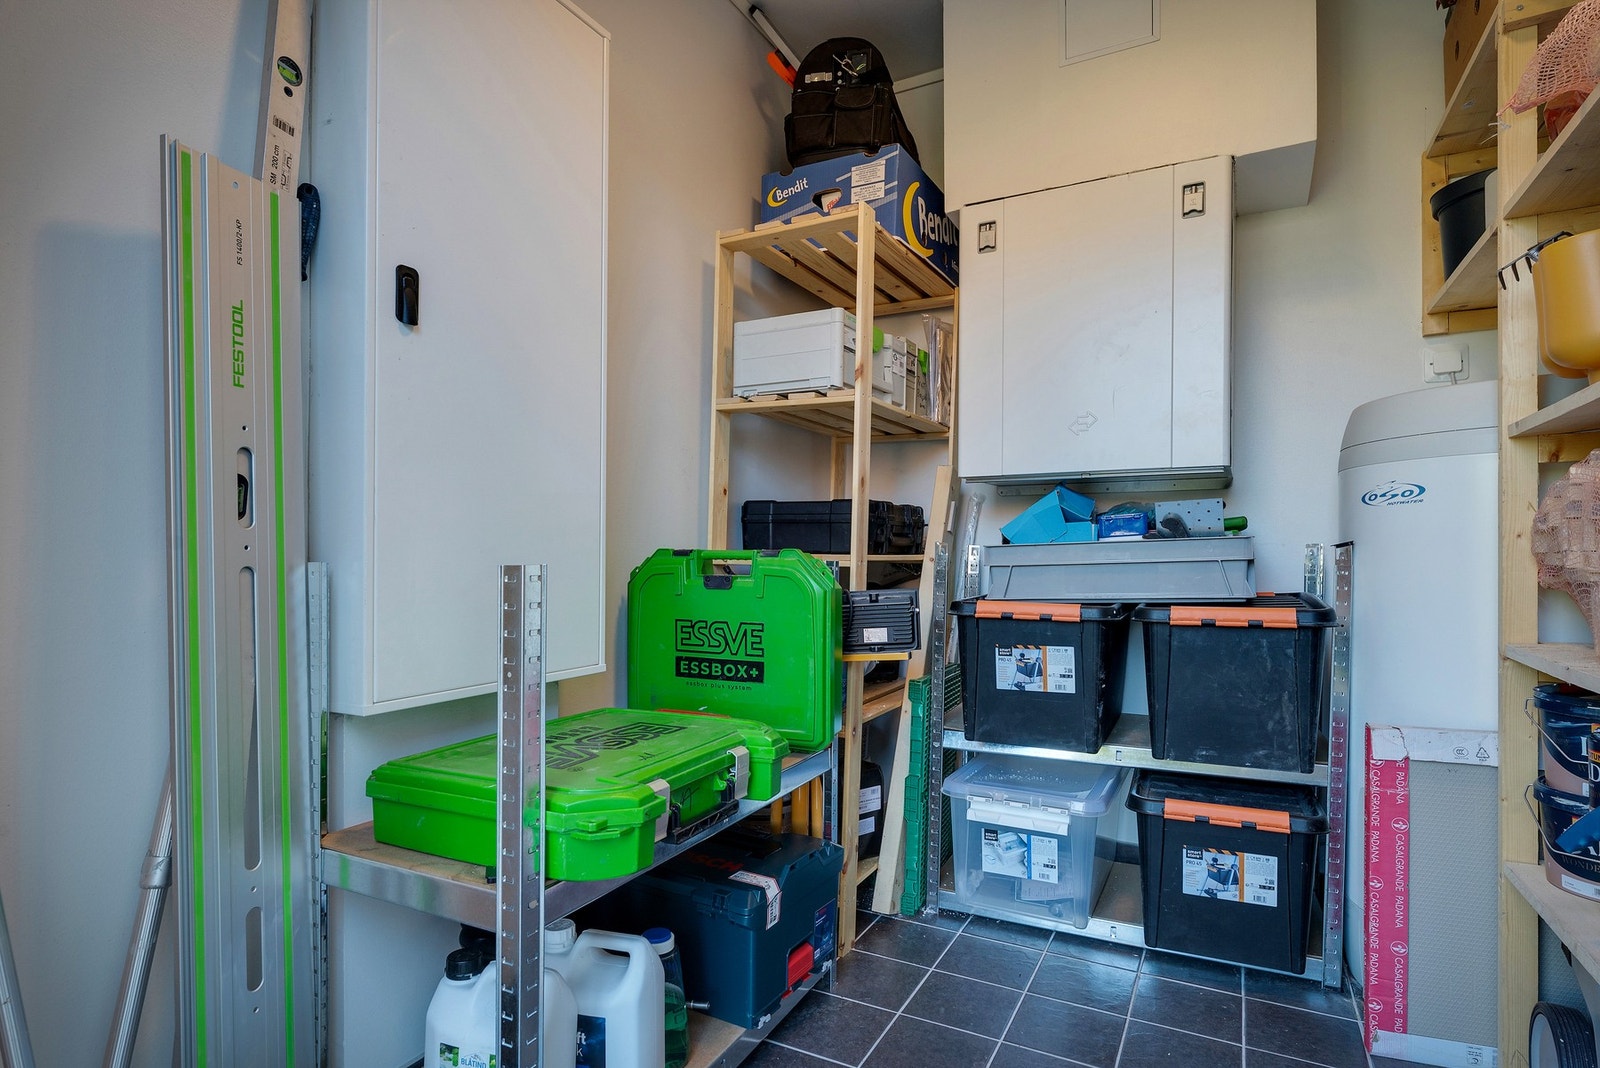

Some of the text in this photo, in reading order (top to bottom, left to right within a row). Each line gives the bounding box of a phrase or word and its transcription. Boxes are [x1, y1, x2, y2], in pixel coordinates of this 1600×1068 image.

[270, 172, 277, 184] SM
[274, 145, 279, 156] cm
[776, 178, 808, 201] Bendit
[237, 256, 242, 265] FS
[232, 300, 245, 388] FESTOOL
[675, 619, 764, 657] ESSVE
[680, 661, 758, 678] ESSBOX+
[1396, 771, 1405, 804] PADANA
[1371, 830, 1380, 863] PADANA
[1395, 895, 1404, 928] PADANA
[1370, 953, 1378, 985] PADANA
